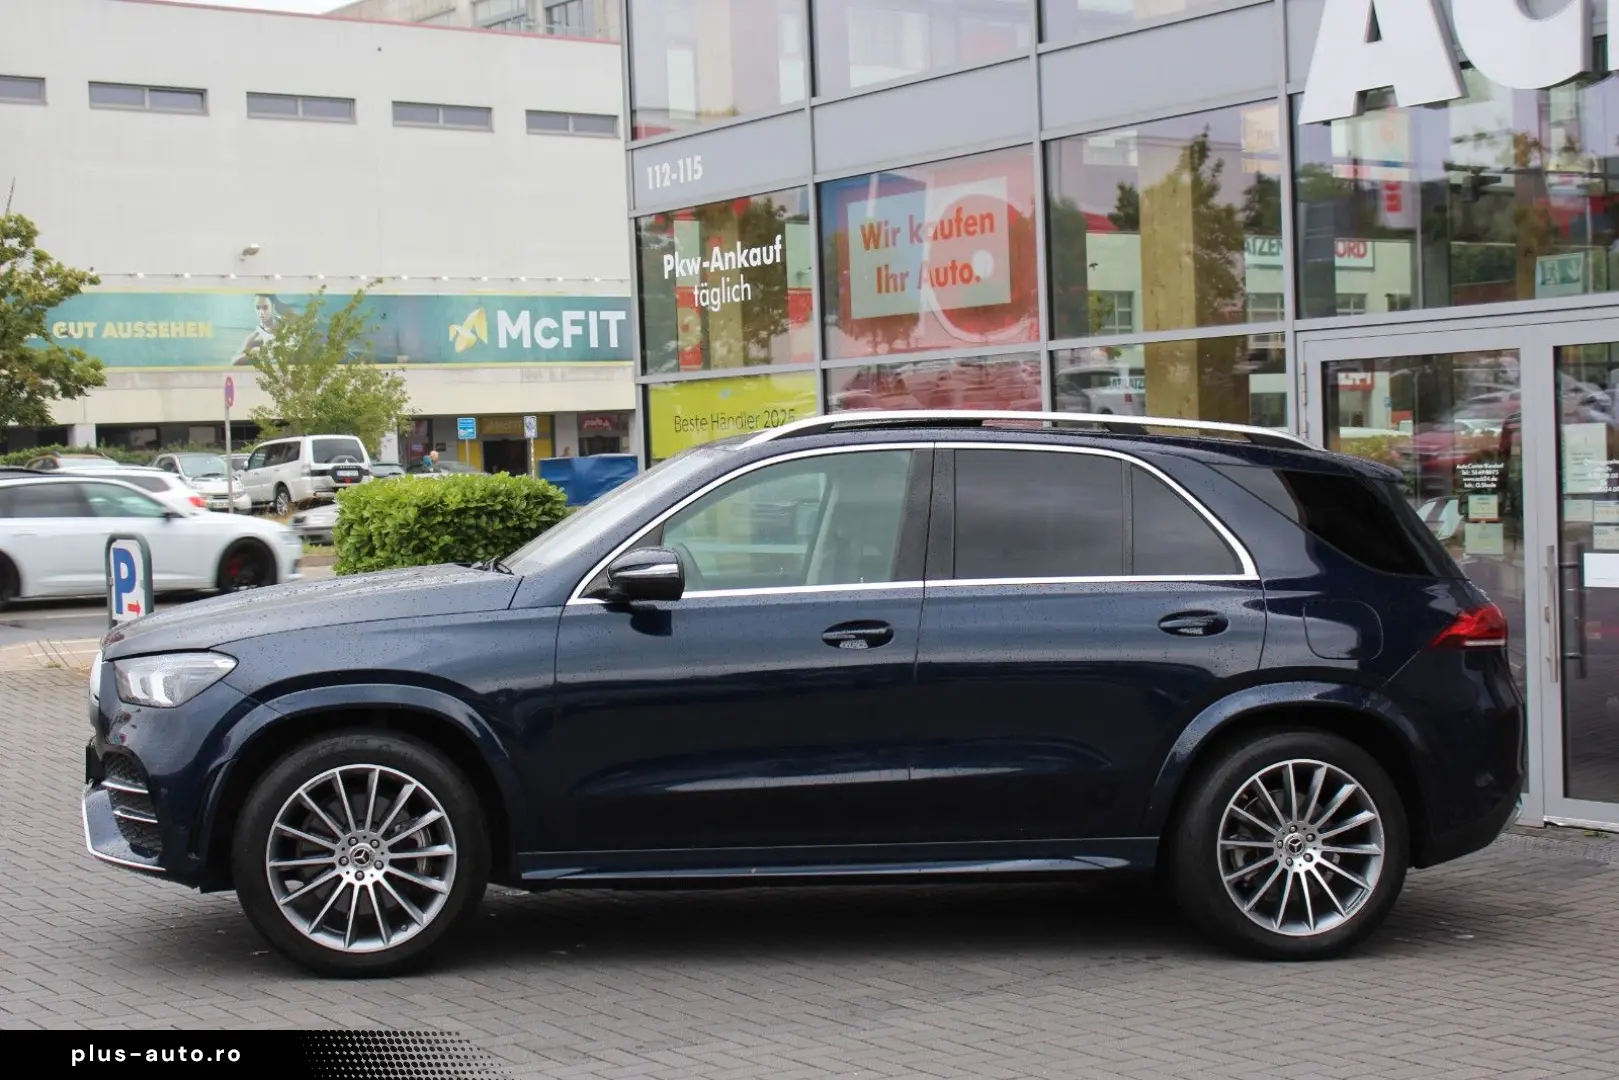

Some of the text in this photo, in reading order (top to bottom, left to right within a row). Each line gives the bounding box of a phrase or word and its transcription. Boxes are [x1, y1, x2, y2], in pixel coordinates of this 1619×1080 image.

[646, 154, 703, 190] 112-115
[860, 219, 901, 251] Wir
[663, 234, 782, 279] Pkw-Ankauf
[693, 274, 752, 312] täglich
[876, 263, 909, 294] Ihr
[52, 321, 97, 339] GUT
[102, 322, 213, 339] AUSSEHEN
[496, 309, 627, 349] McFIT
[674, 415, 708, 433] Beste
[711, 412, 760, 432] Händler
[112, 547, 137, 615] P
